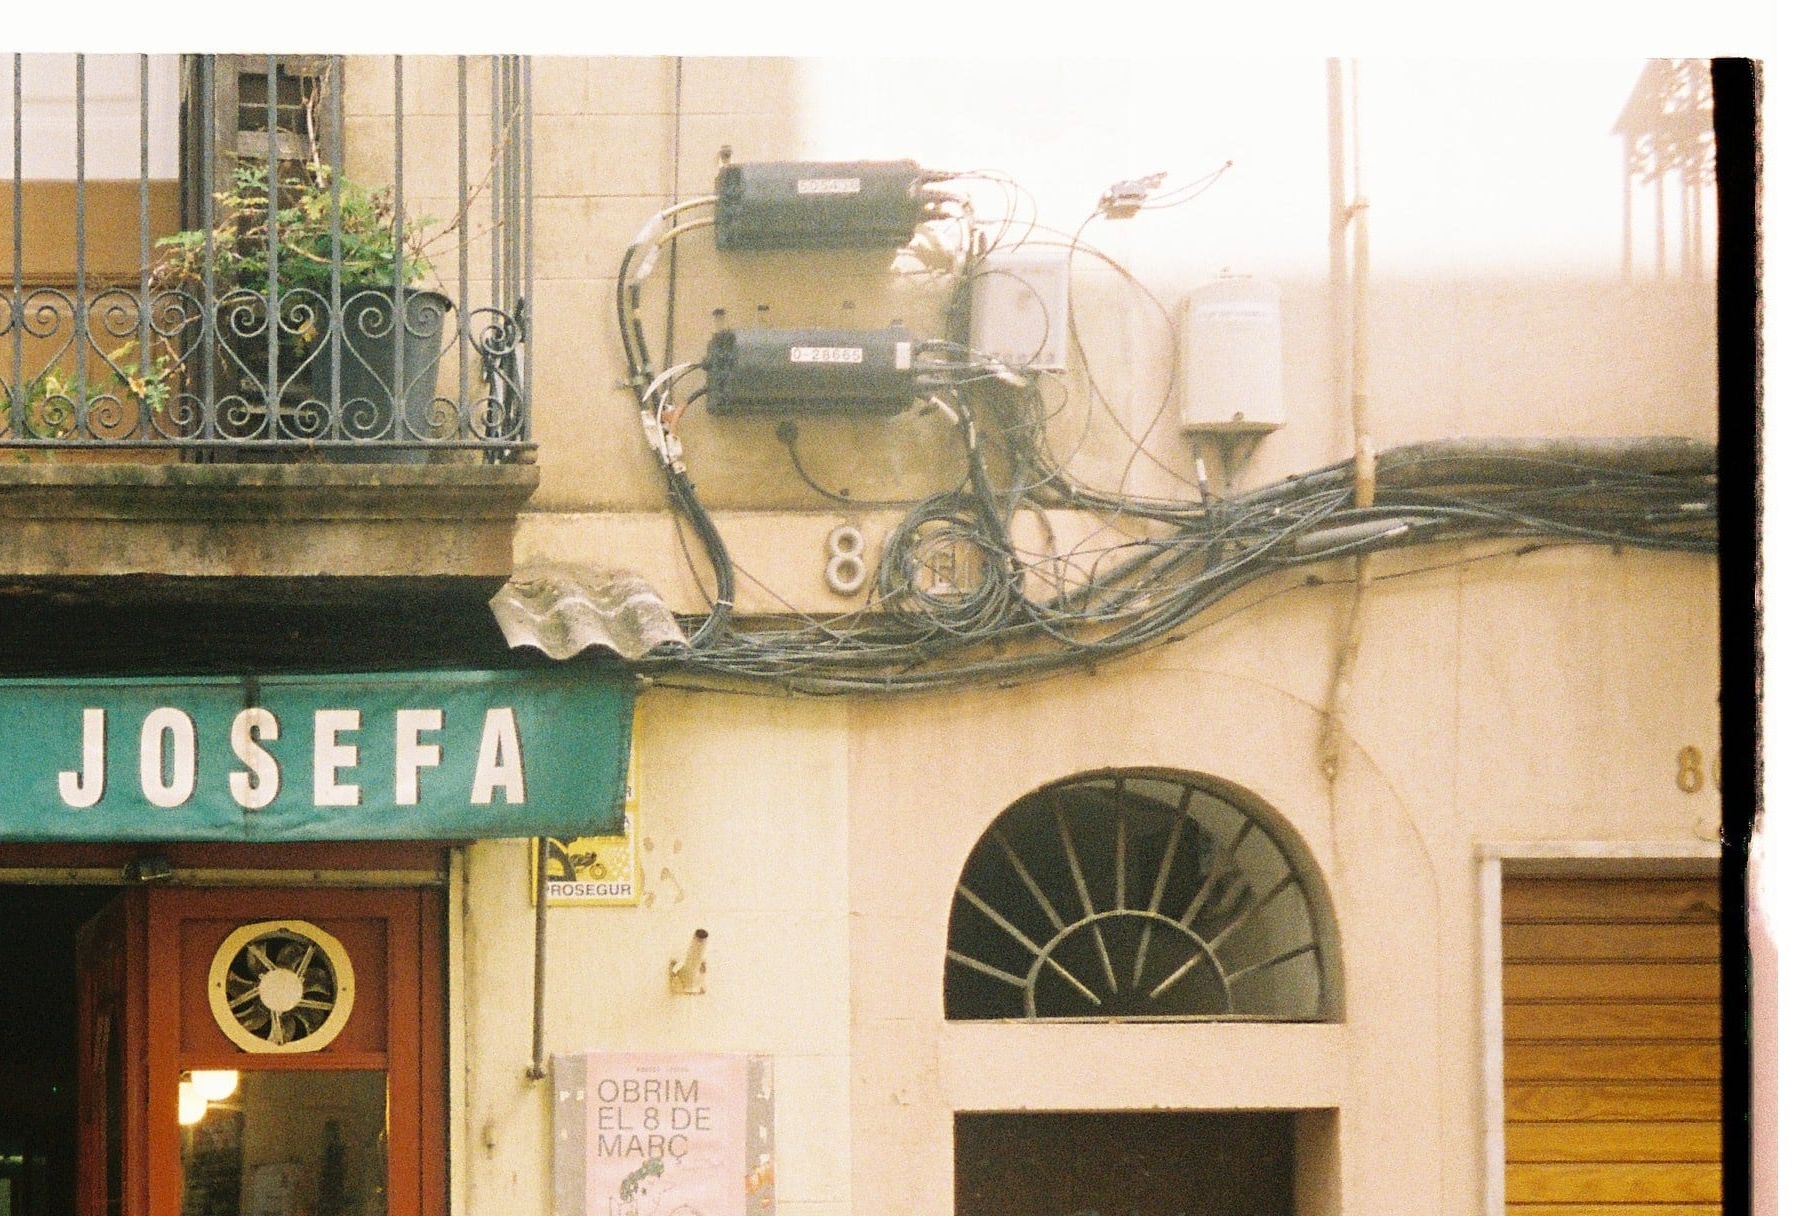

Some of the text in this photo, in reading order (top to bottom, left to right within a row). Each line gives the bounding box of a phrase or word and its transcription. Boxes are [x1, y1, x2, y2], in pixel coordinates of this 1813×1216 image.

[57, 704, 529, 809] JOSEFA
[1676, 745, 1722, 793] 8
[597, 1078, 700, 1104] OBRIM
[597, 1106, 713, 1131] EL 8 DE
[597, 1133, 689, 1165] MARÇ
